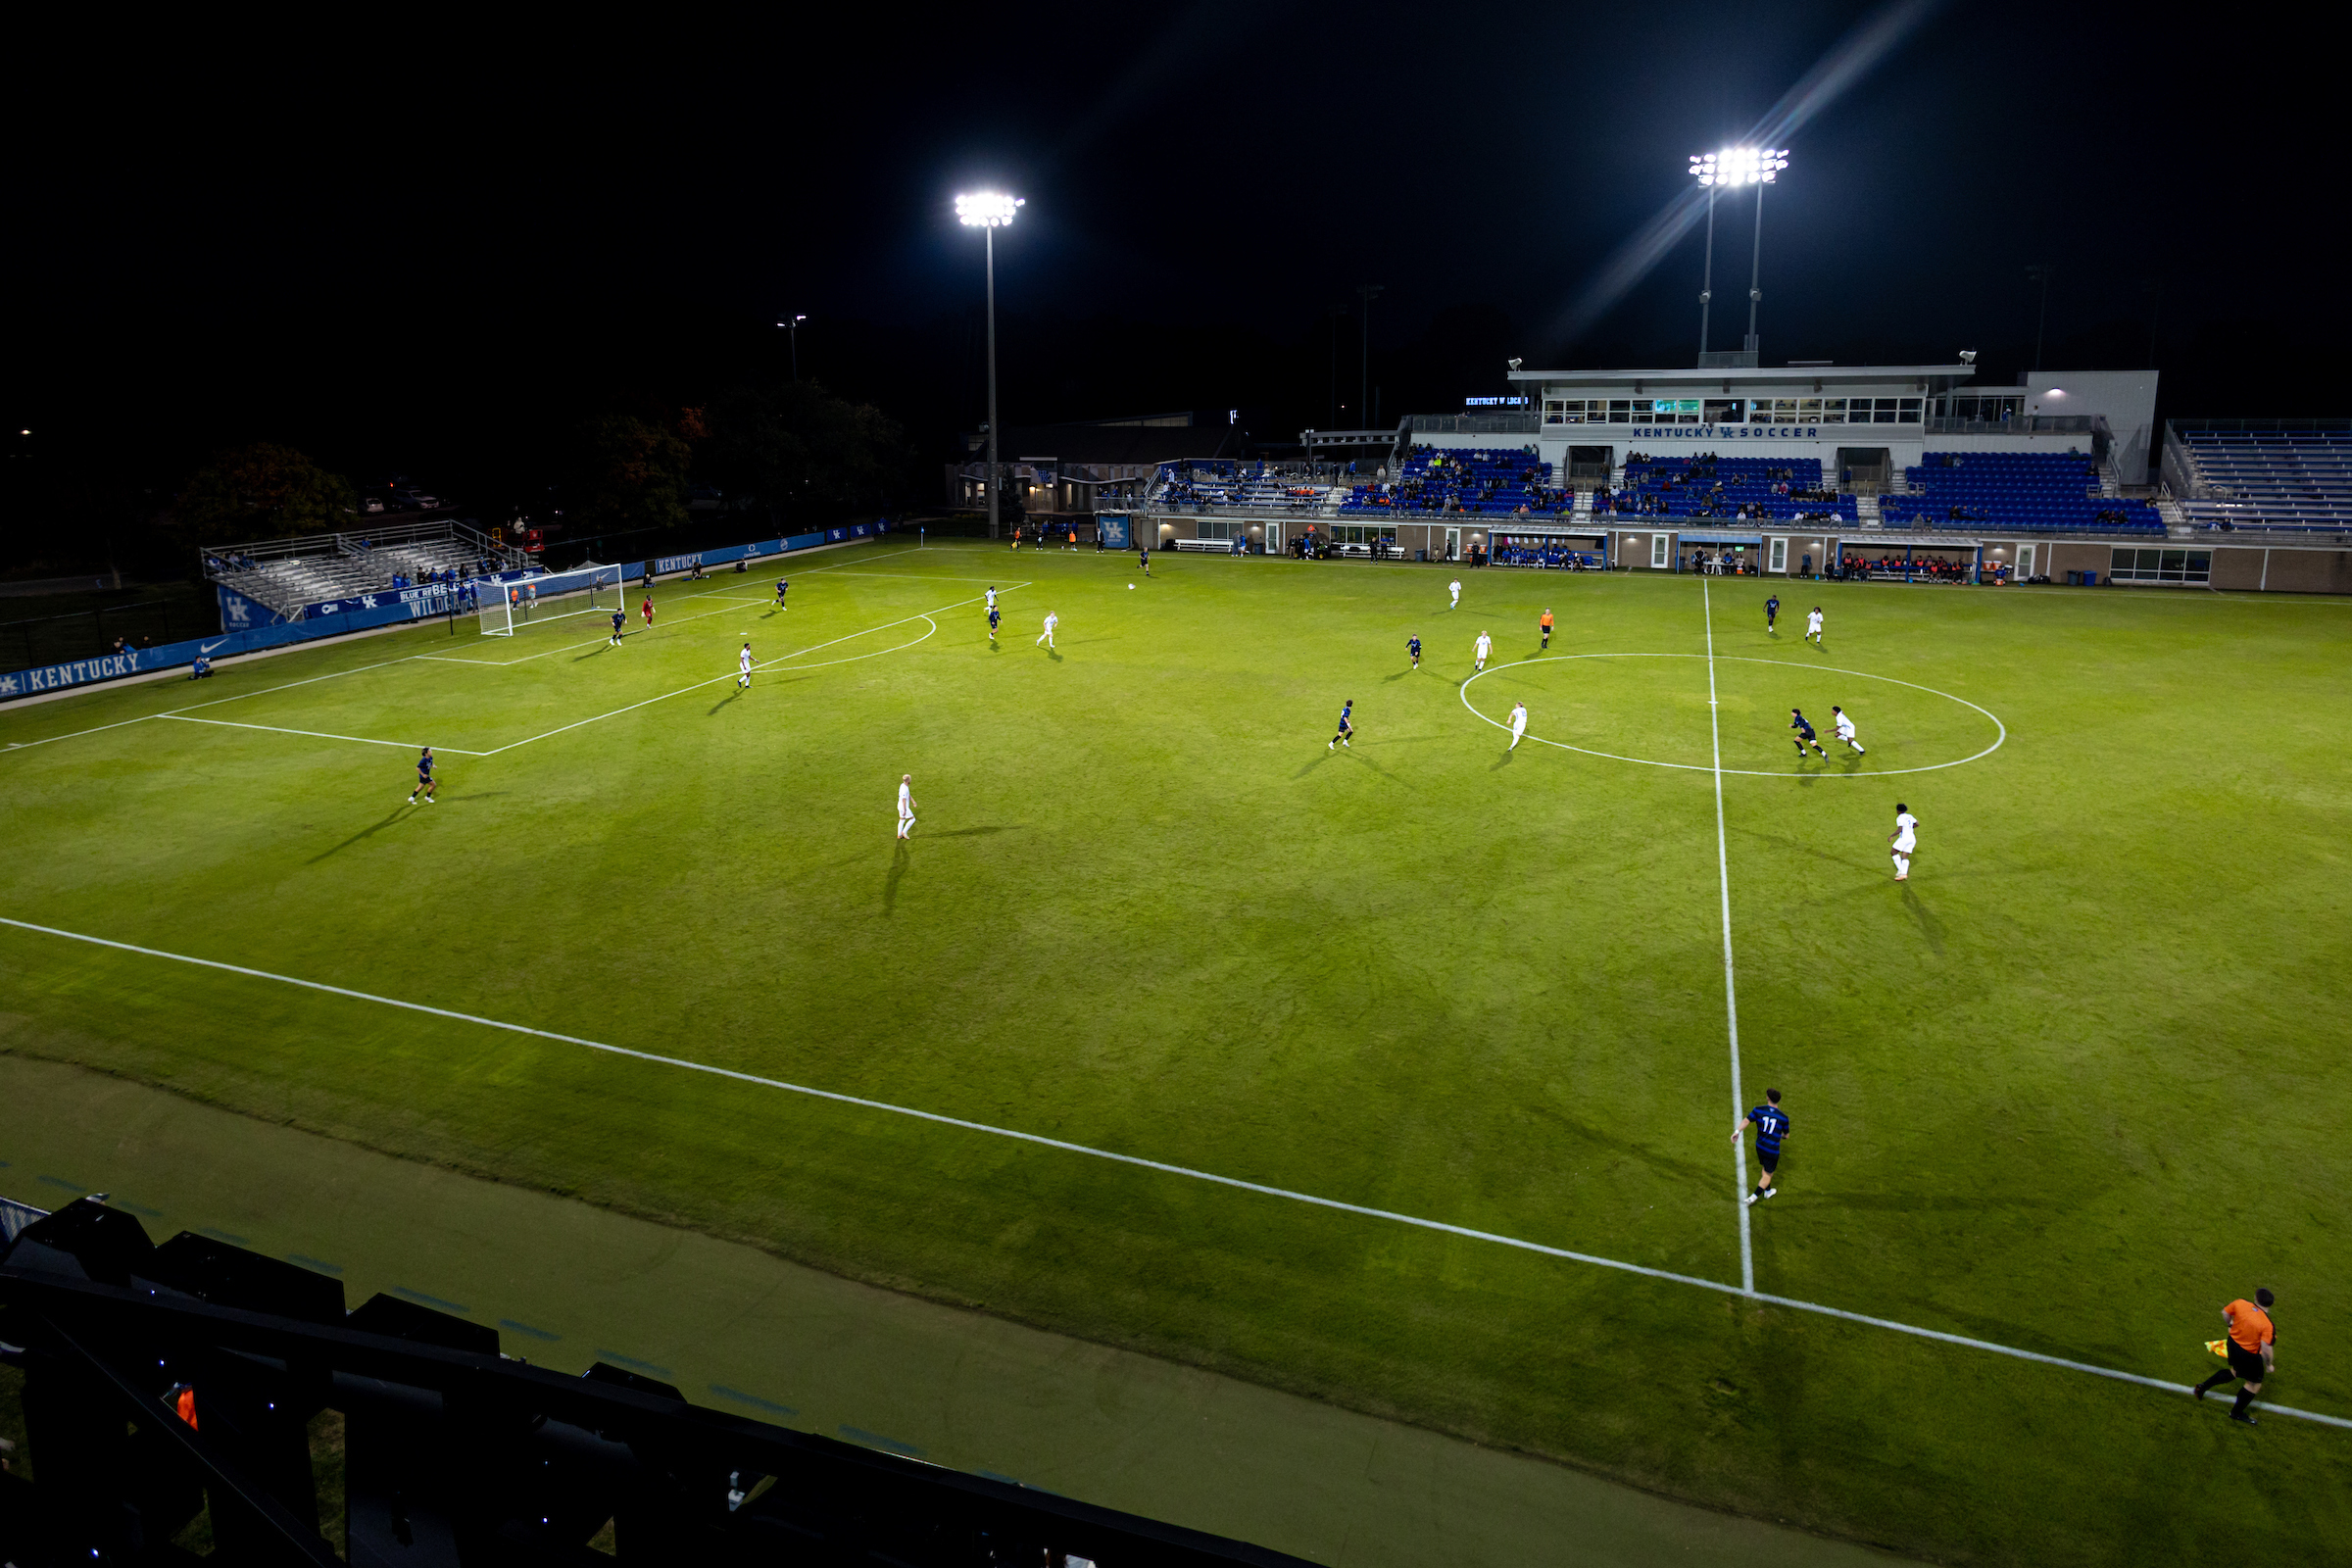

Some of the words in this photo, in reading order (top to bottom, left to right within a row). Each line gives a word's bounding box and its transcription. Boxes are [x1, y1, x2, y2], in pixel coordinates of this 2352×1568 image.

[1466, 397, 1498, 406] KENTUCKY
[1499, 396, 1529, 405] WLDCAS
[1634, 427, 1714, 438] KENTUCKY
[1740, 427, 1817, 438] SOCCER
[659, 554, 703, 572] KENTUCKY
[400, 590, 419, 600] BLUE
[29, 653, 139, 691] KENTUCKY
[1762, 1116, 1777, 1134] 11
